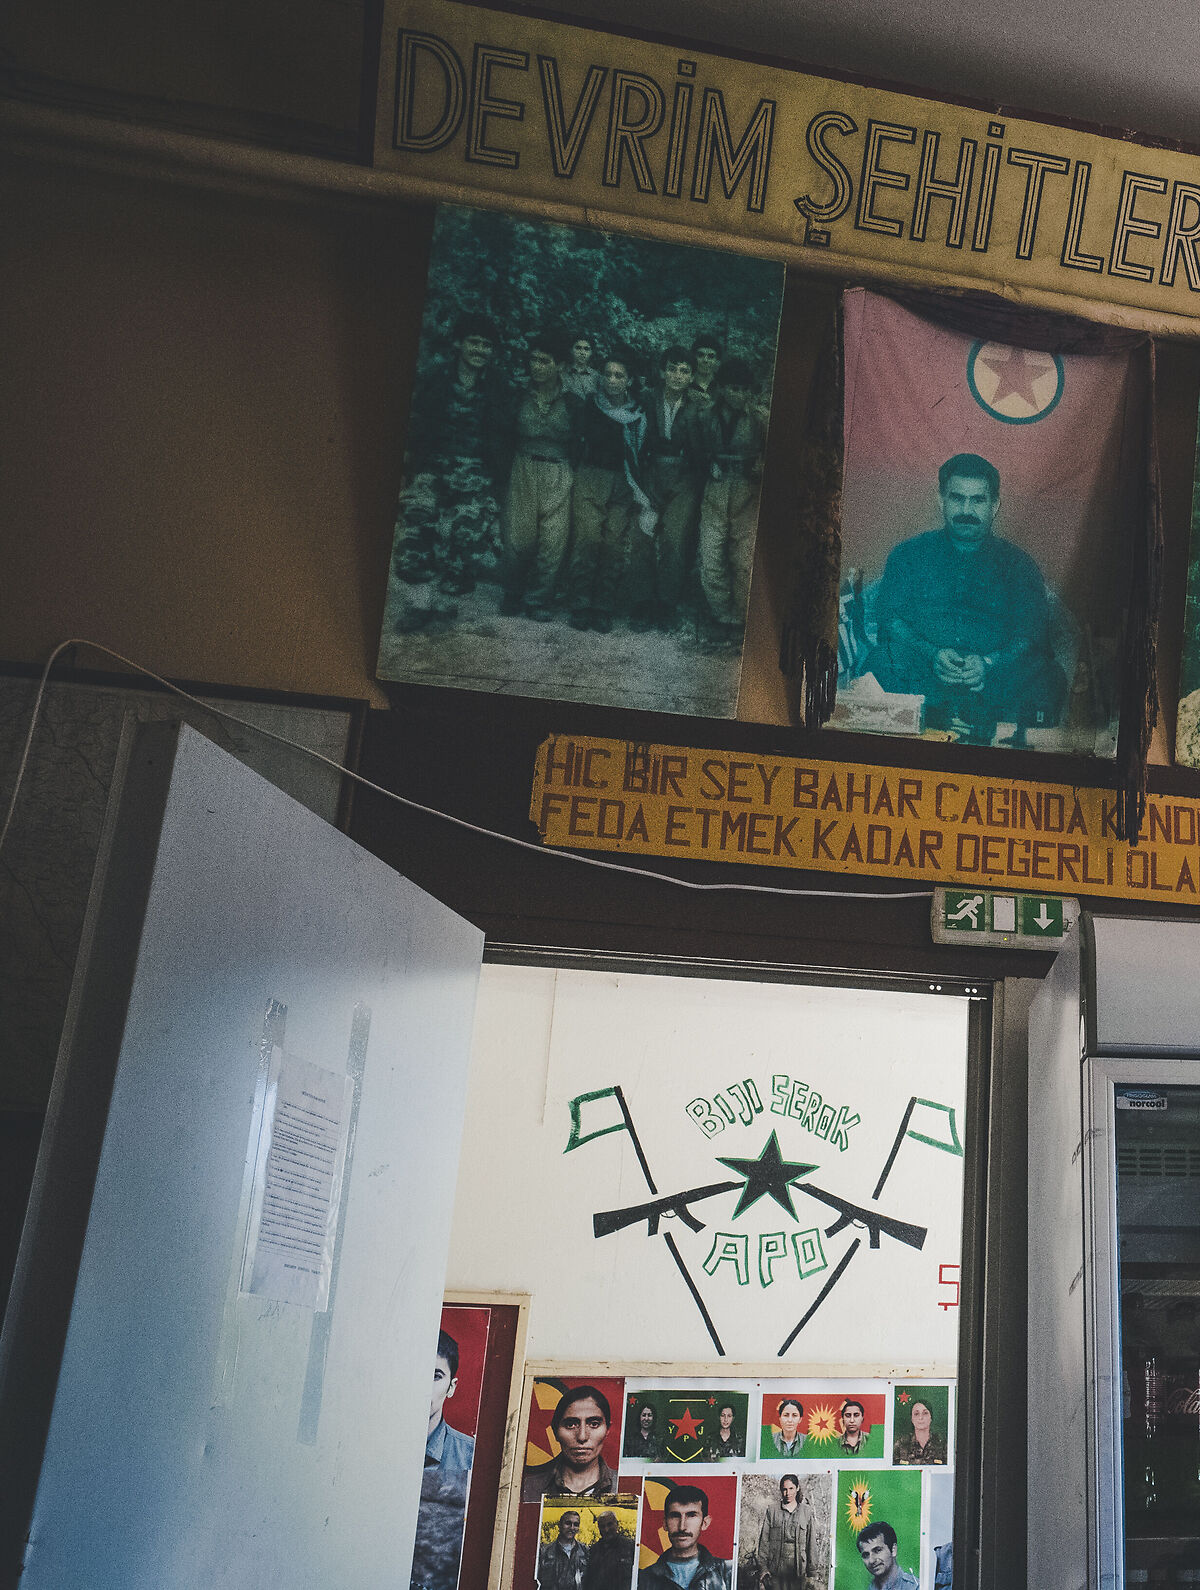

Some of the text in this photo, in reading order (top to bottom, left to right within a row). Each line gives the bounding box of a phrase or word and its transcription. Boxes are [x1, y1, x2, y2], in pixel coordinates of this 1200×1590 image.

[393, 28, 776, 213] DEVRİM
[794, 768, 922, 819] BAHAR
[540, 792, 649, 842] FEDA
[665, 806, 799, 857] ETMEK
[812, 819, 943, 870] KADAR
[685, 1074, 860, 1152] BIJI SEROK
[1130, 1099, 1165, 1108] norcool
[702, 1228, 828, 1288] APO
